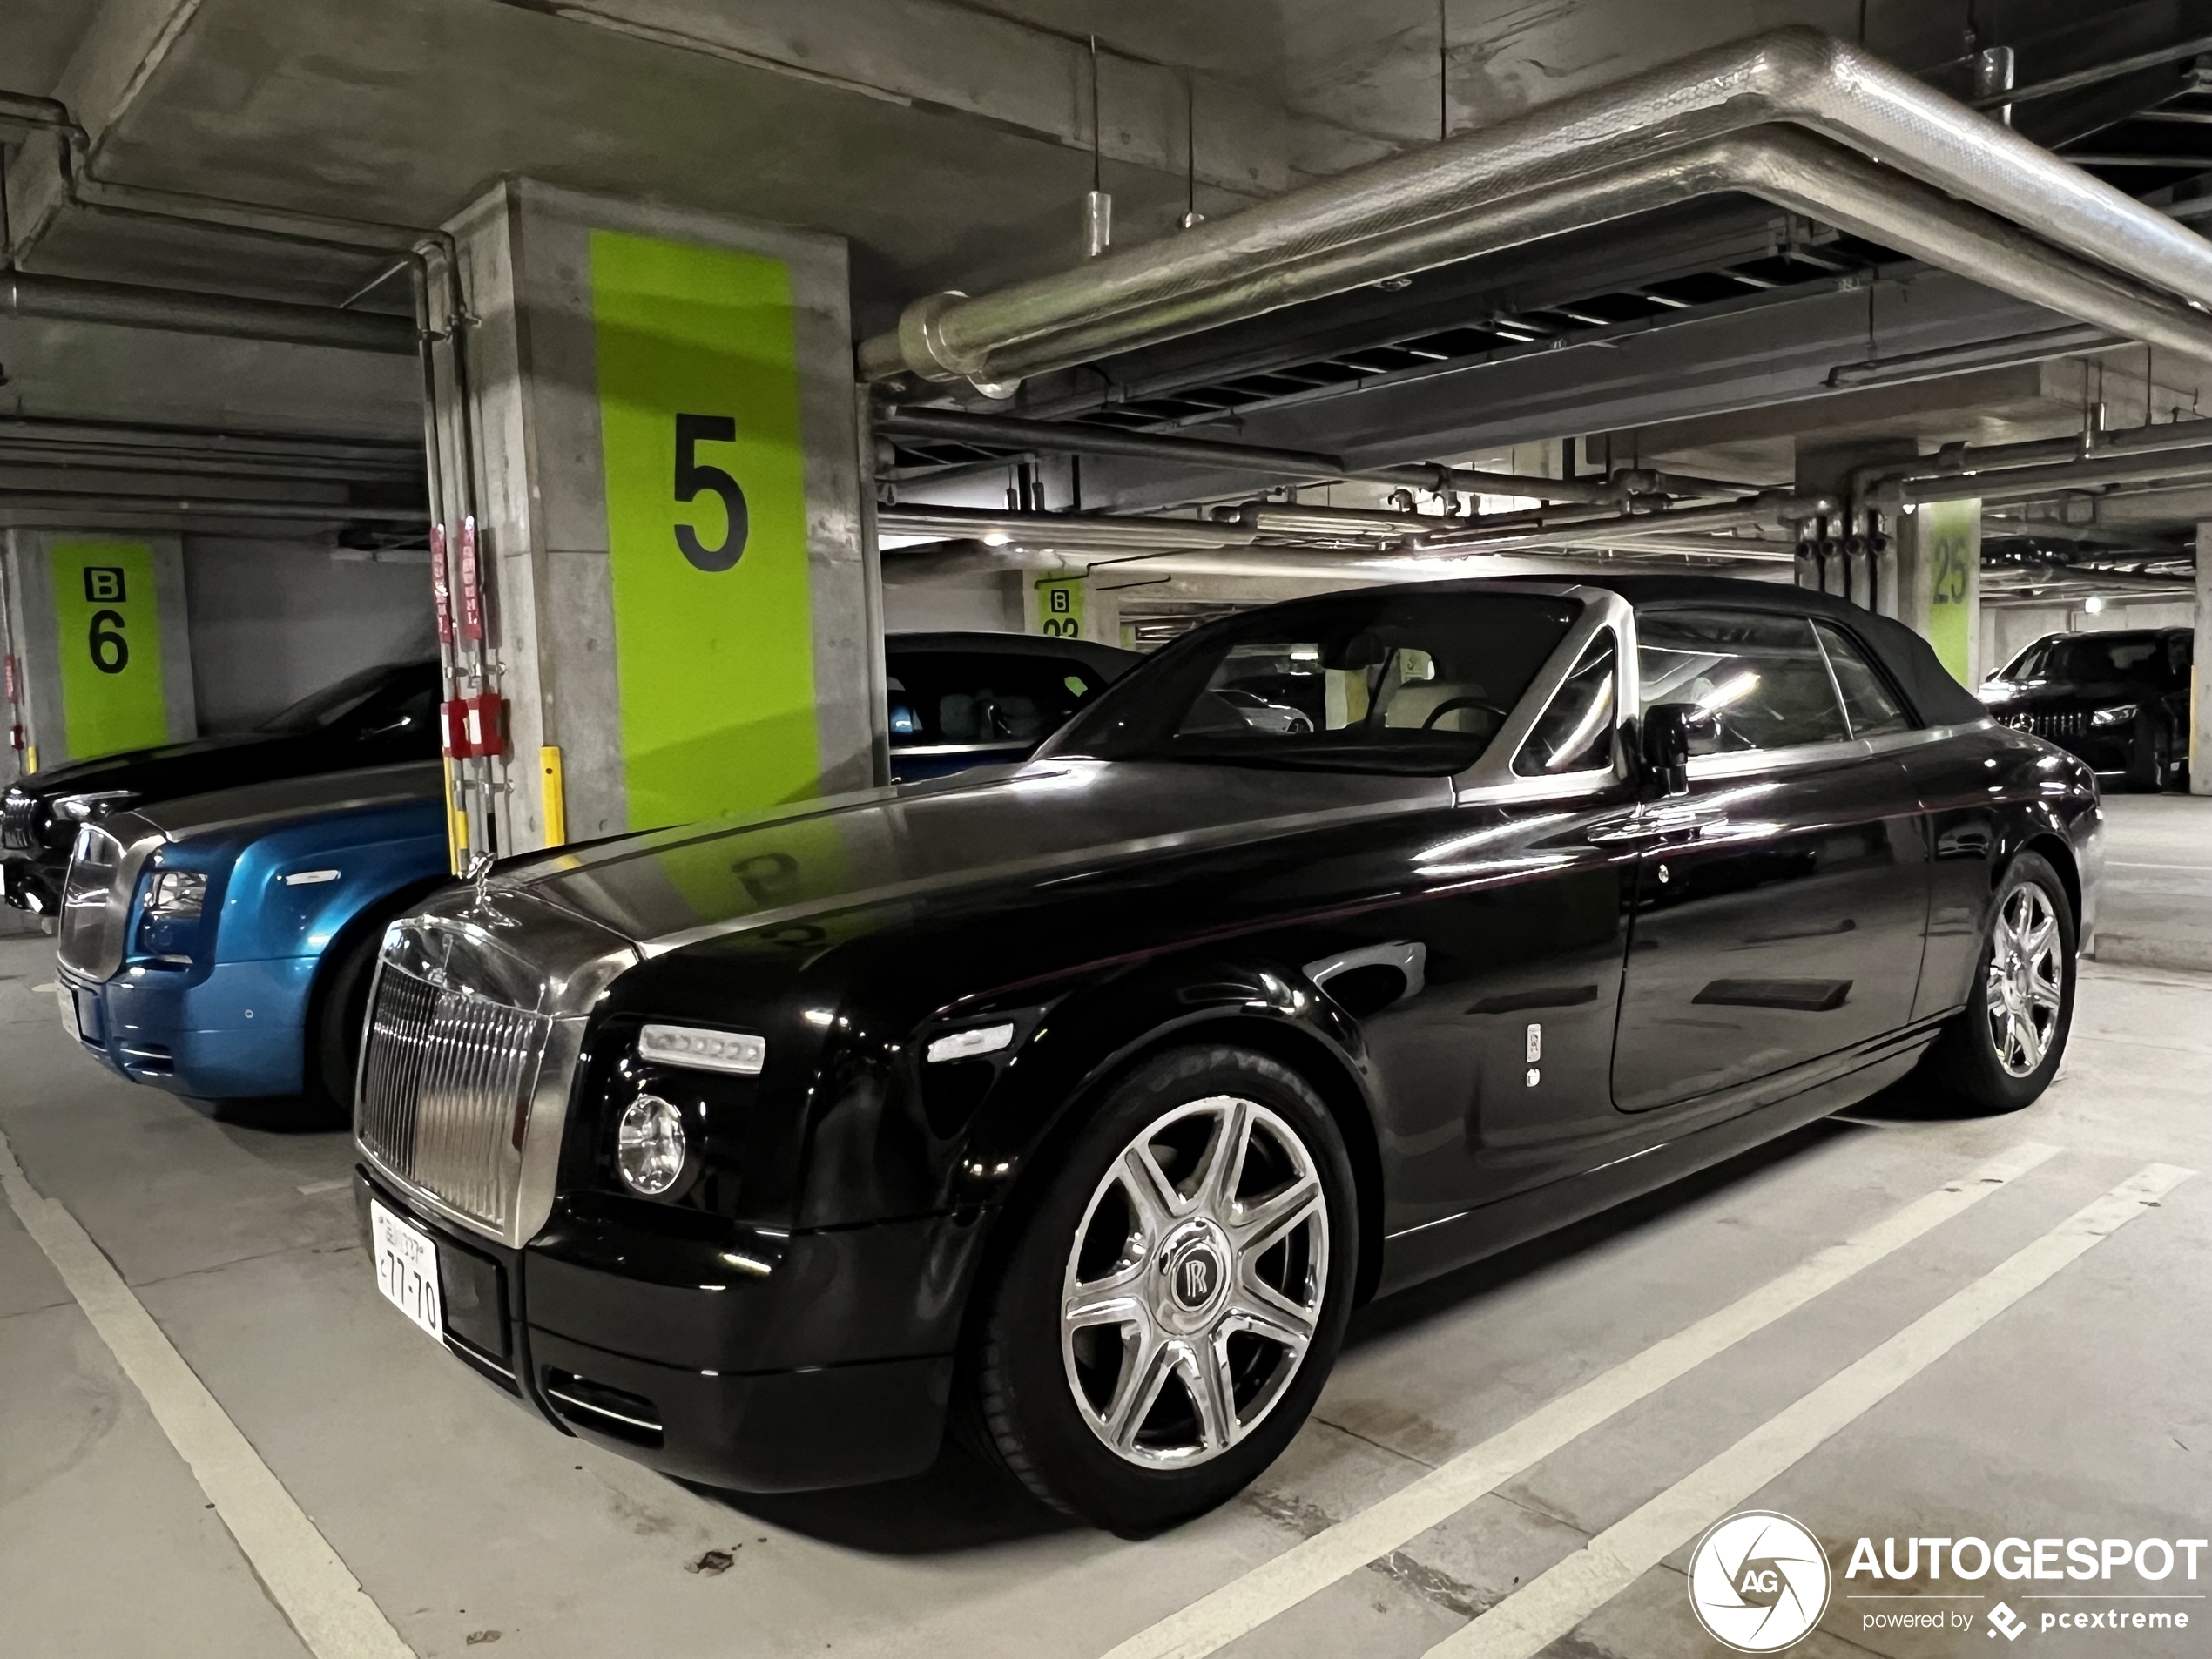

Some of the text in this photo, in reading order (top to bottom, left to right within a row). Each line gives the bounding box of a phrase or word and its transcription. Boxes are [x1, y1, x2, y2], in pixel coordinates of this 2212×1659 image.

[674, 413, 749, 573] 5
[91, 570, 119, 599] B
[1054, 591, 1067, 610] B
[89, 610, 129, 675] 6
